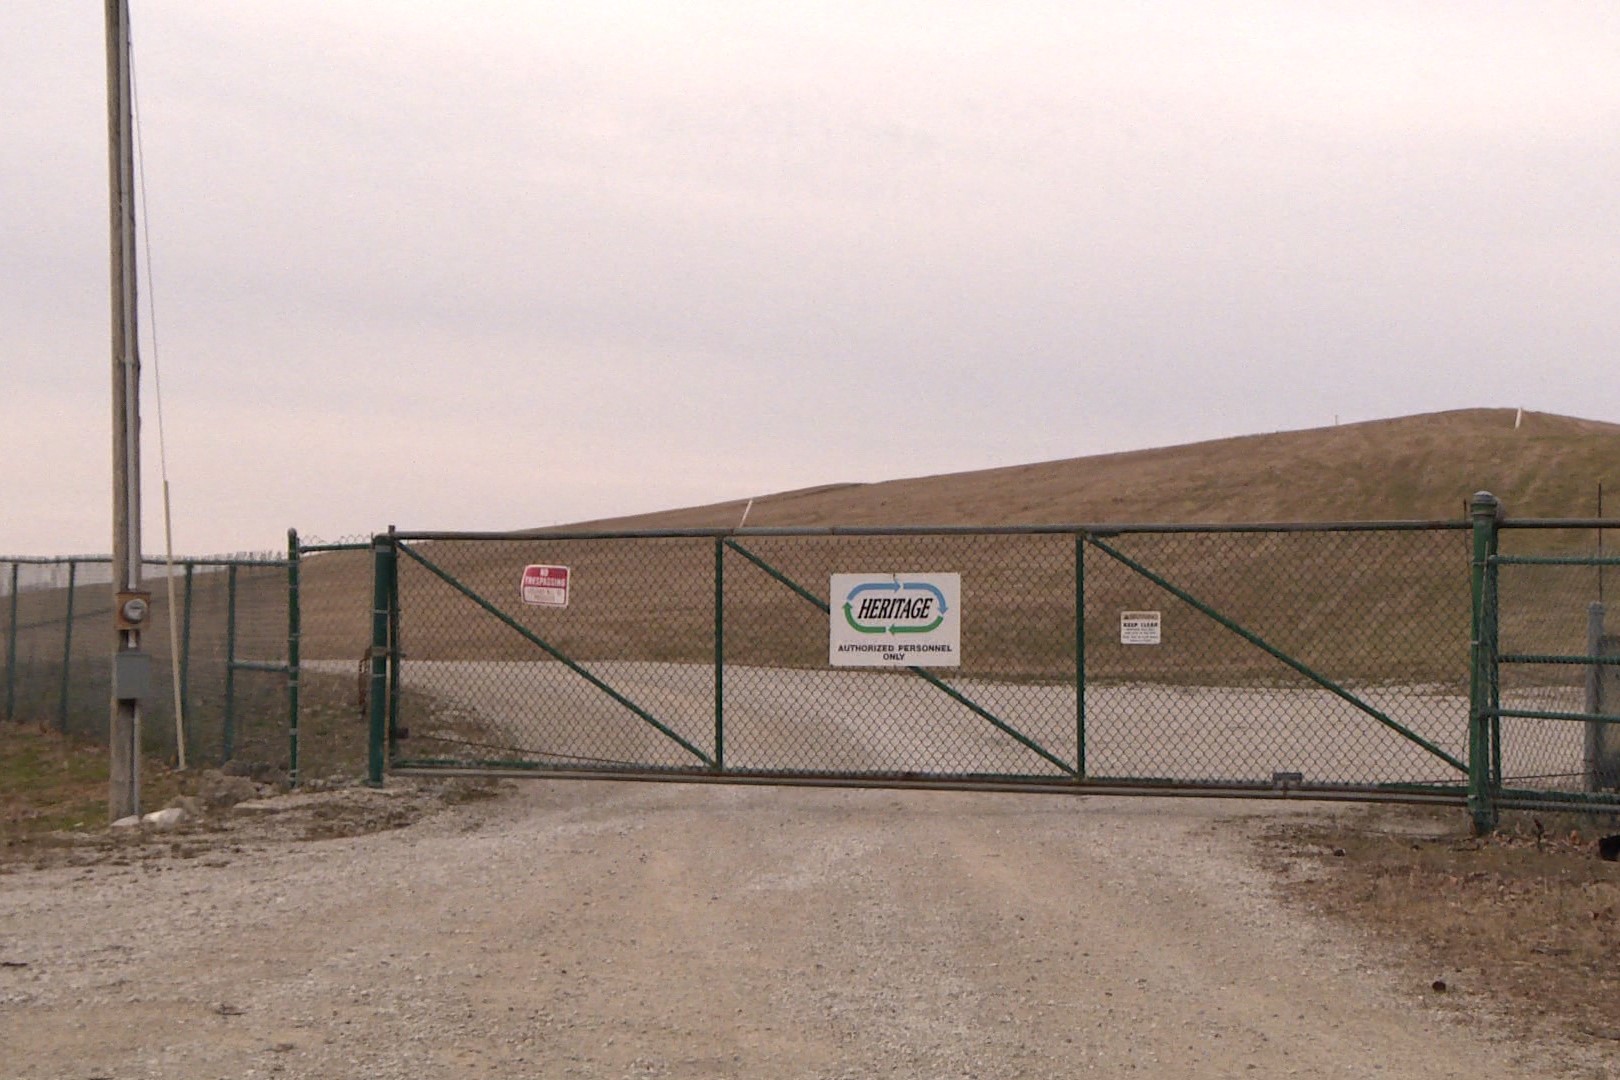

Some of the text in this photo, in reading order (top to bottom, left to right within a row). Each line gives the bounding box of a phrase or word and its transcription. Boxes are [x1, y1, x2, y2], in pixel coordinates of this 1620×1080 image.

[525, 577, 566, 587] TRESPASSING
[857, 598, 933, 619] HERITAGE
[838, 644, 952, 653] AUTHORIZED PERSONNEL
[882, 653, 905, 661] ONLY
